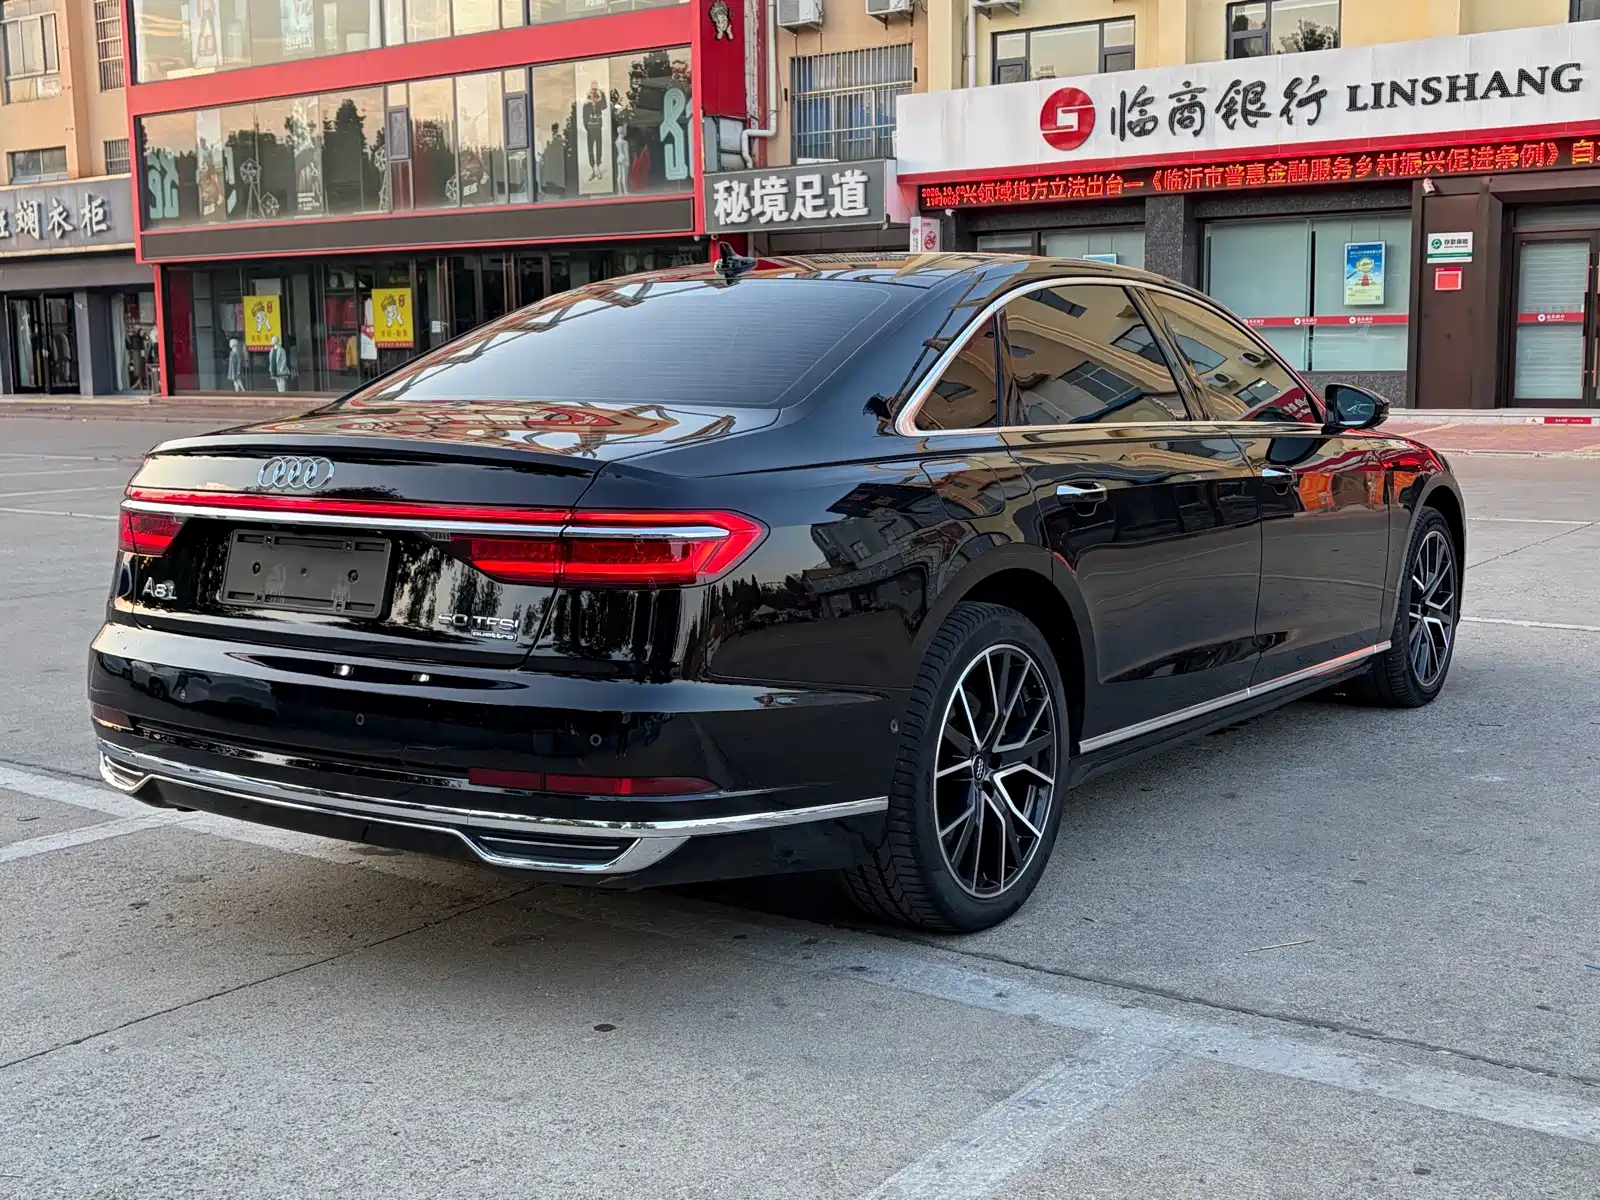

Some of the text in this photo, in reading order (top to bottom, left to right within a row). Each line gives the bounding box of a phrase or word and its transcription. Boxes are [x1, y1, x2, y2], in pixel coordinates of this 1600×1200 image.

[1110, 62, 1583, 142] 临商银行 LINSHANG
[713, 169, 870, 226] 秘境足道
[438, 612, 520, 631] 50 TFSI
[472, 630, 516, 641] quattro
